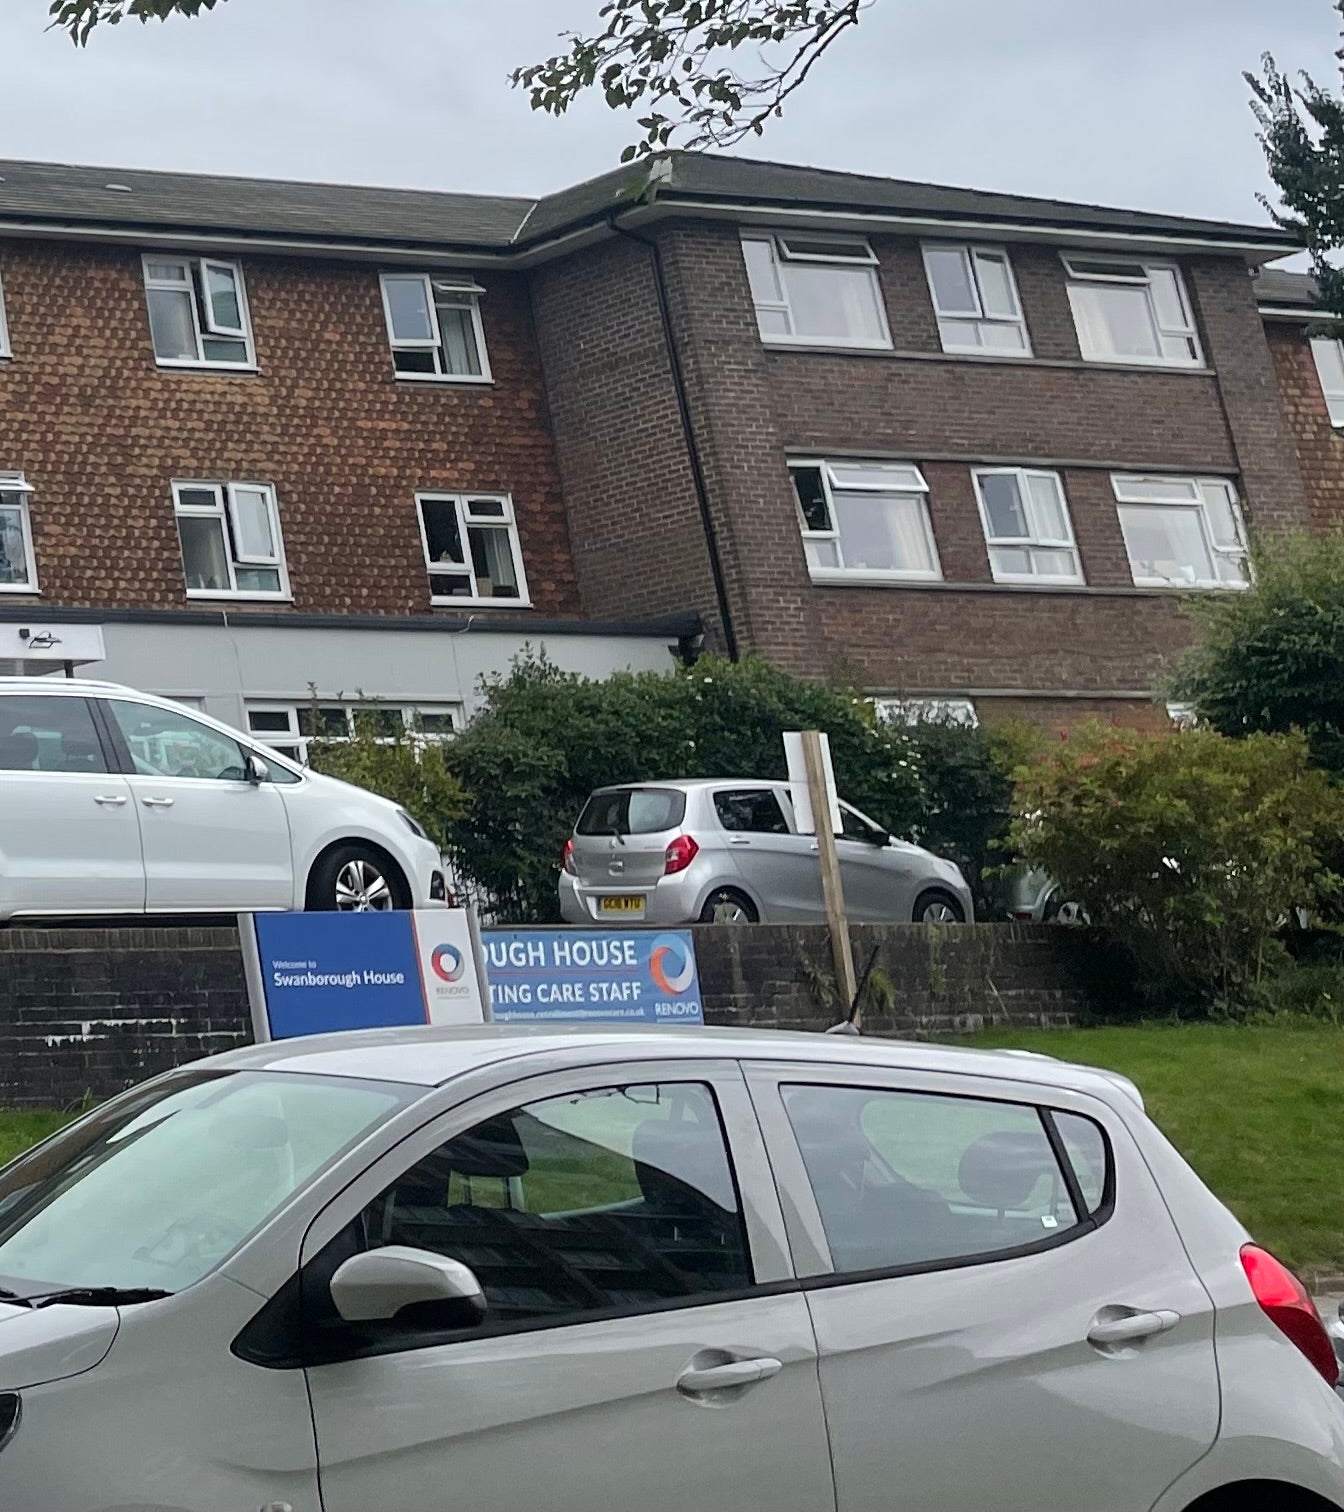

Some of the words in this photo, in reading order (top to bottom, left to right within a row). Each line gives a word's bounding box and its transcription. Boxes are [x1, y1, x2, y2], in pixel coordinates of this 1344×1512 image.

[553, 940, 638, 966] HOUSE
[272, 960, 306, 970] Welcome
[273, 971, 361, 987] Swanborough
[363, 970, 405, 985] House
[537, 982, 585, 1003] CARE
[590, 981, 641, 1001] STAFF
[655, 1001, 699, 1016] RENOVO
